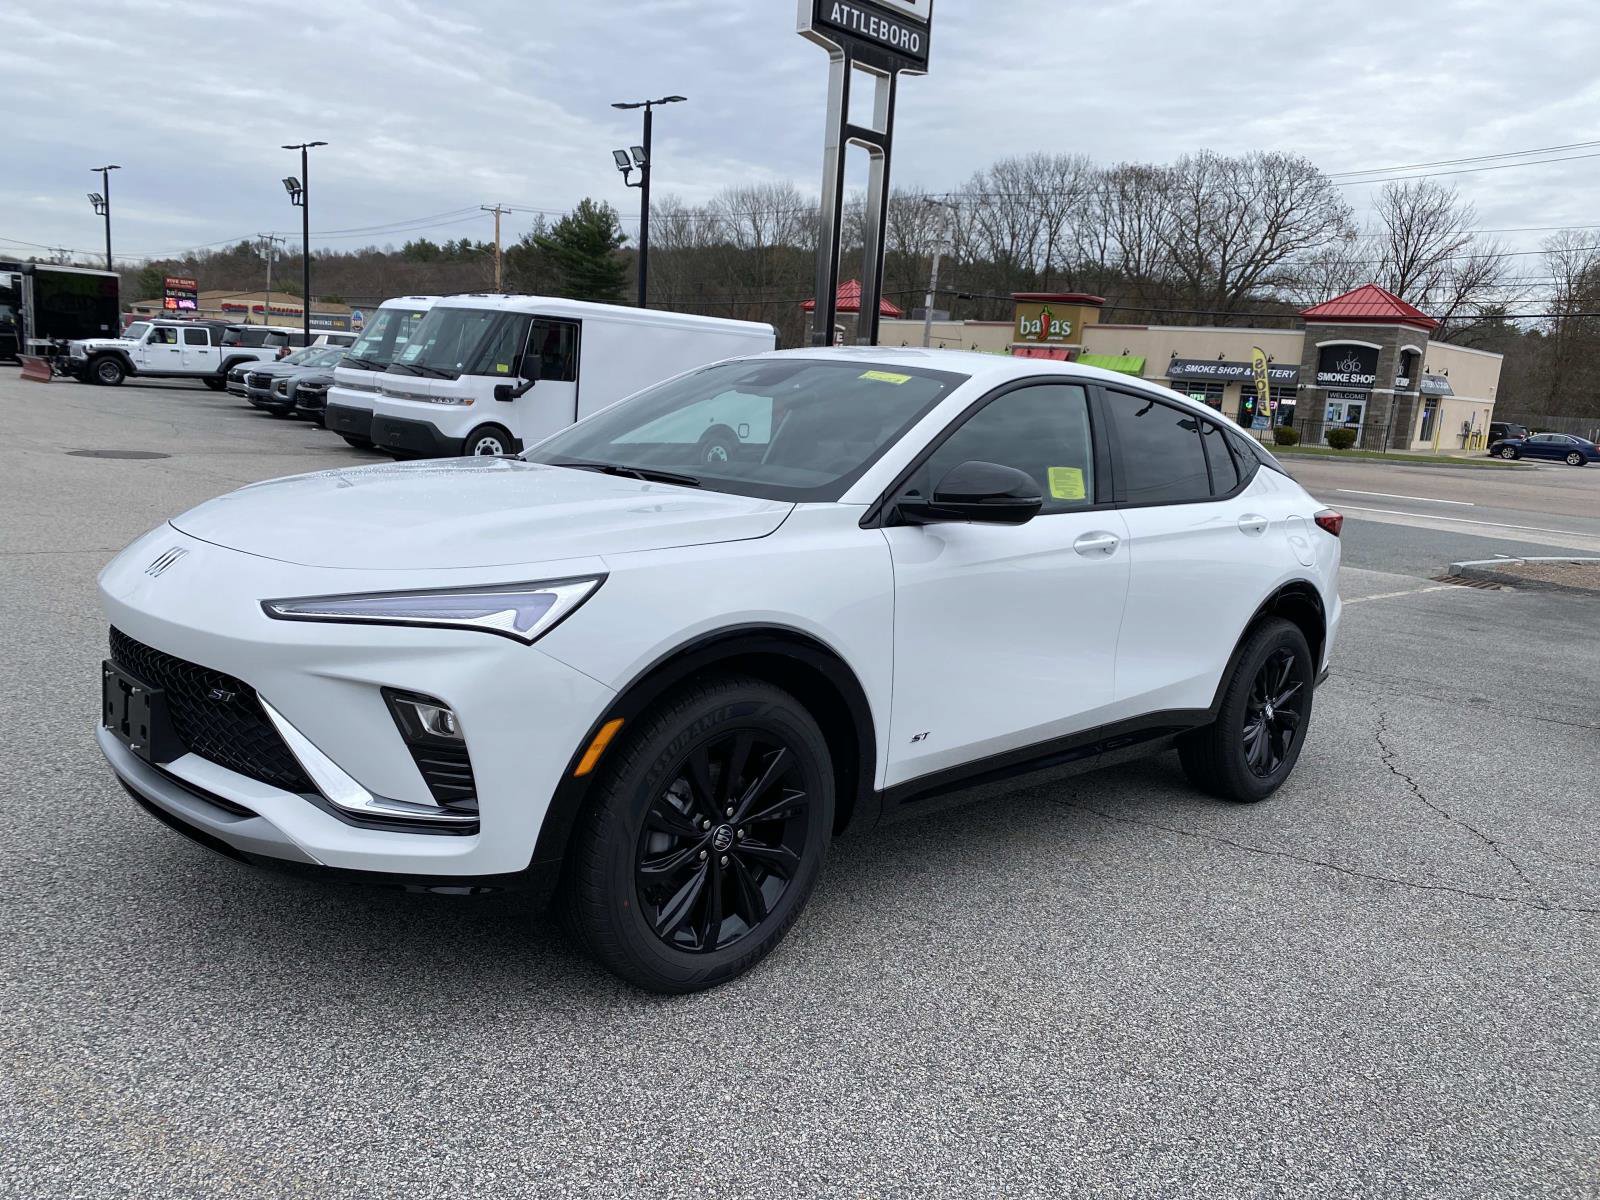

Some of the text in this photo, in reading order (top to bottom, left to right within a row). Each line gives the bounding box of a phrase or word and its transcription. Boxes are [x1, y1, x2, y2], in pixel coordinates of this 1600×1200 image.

[830, 2, 920, 52] ATTLEBORO
[1185, 364, 1217, 374] SMOKE
[1217, 366, 1243, 375] SHOP
[1244, 367, 1251, 376] &
[1316, 372, 1376, 384] SMOKE SHOP
[1329, 392, 1365, 400] WELCOME
[209, 689, 236, 702] ST
[909, 731, 931, 744] ST
